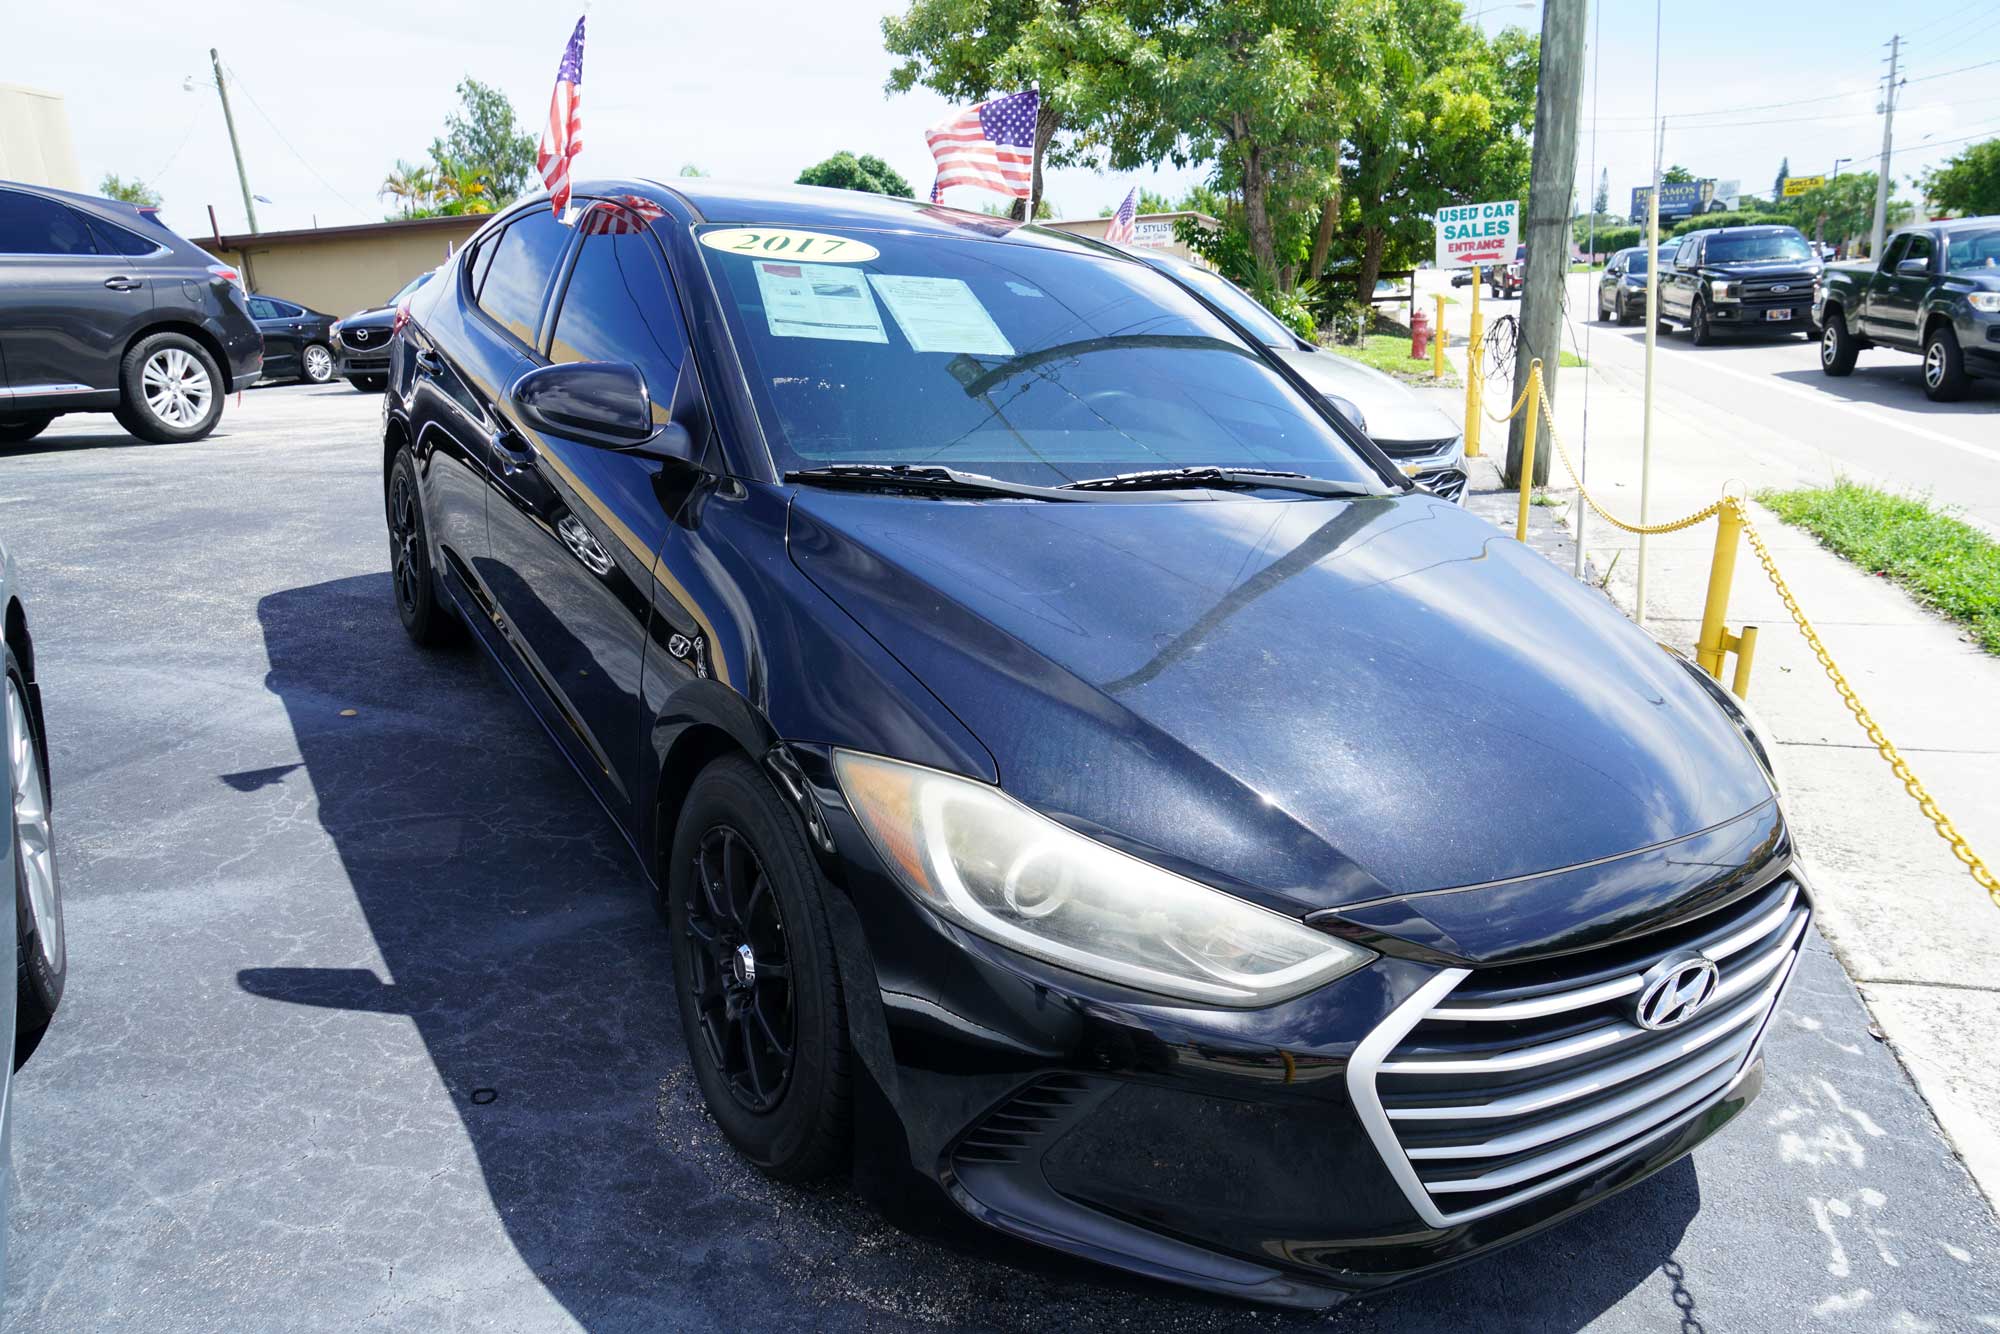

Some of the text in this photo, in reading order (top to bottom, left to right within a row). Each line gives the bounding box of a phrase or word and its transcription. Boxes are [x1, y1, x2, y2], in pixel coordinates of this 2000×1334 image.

[1439, 203, 1515, 222] USED CAR
[1444, 220, 1510, 240] SALES
[732, 234, 847, 255] 2017
[1448, 239, 1505, 253] ENTRANCE
